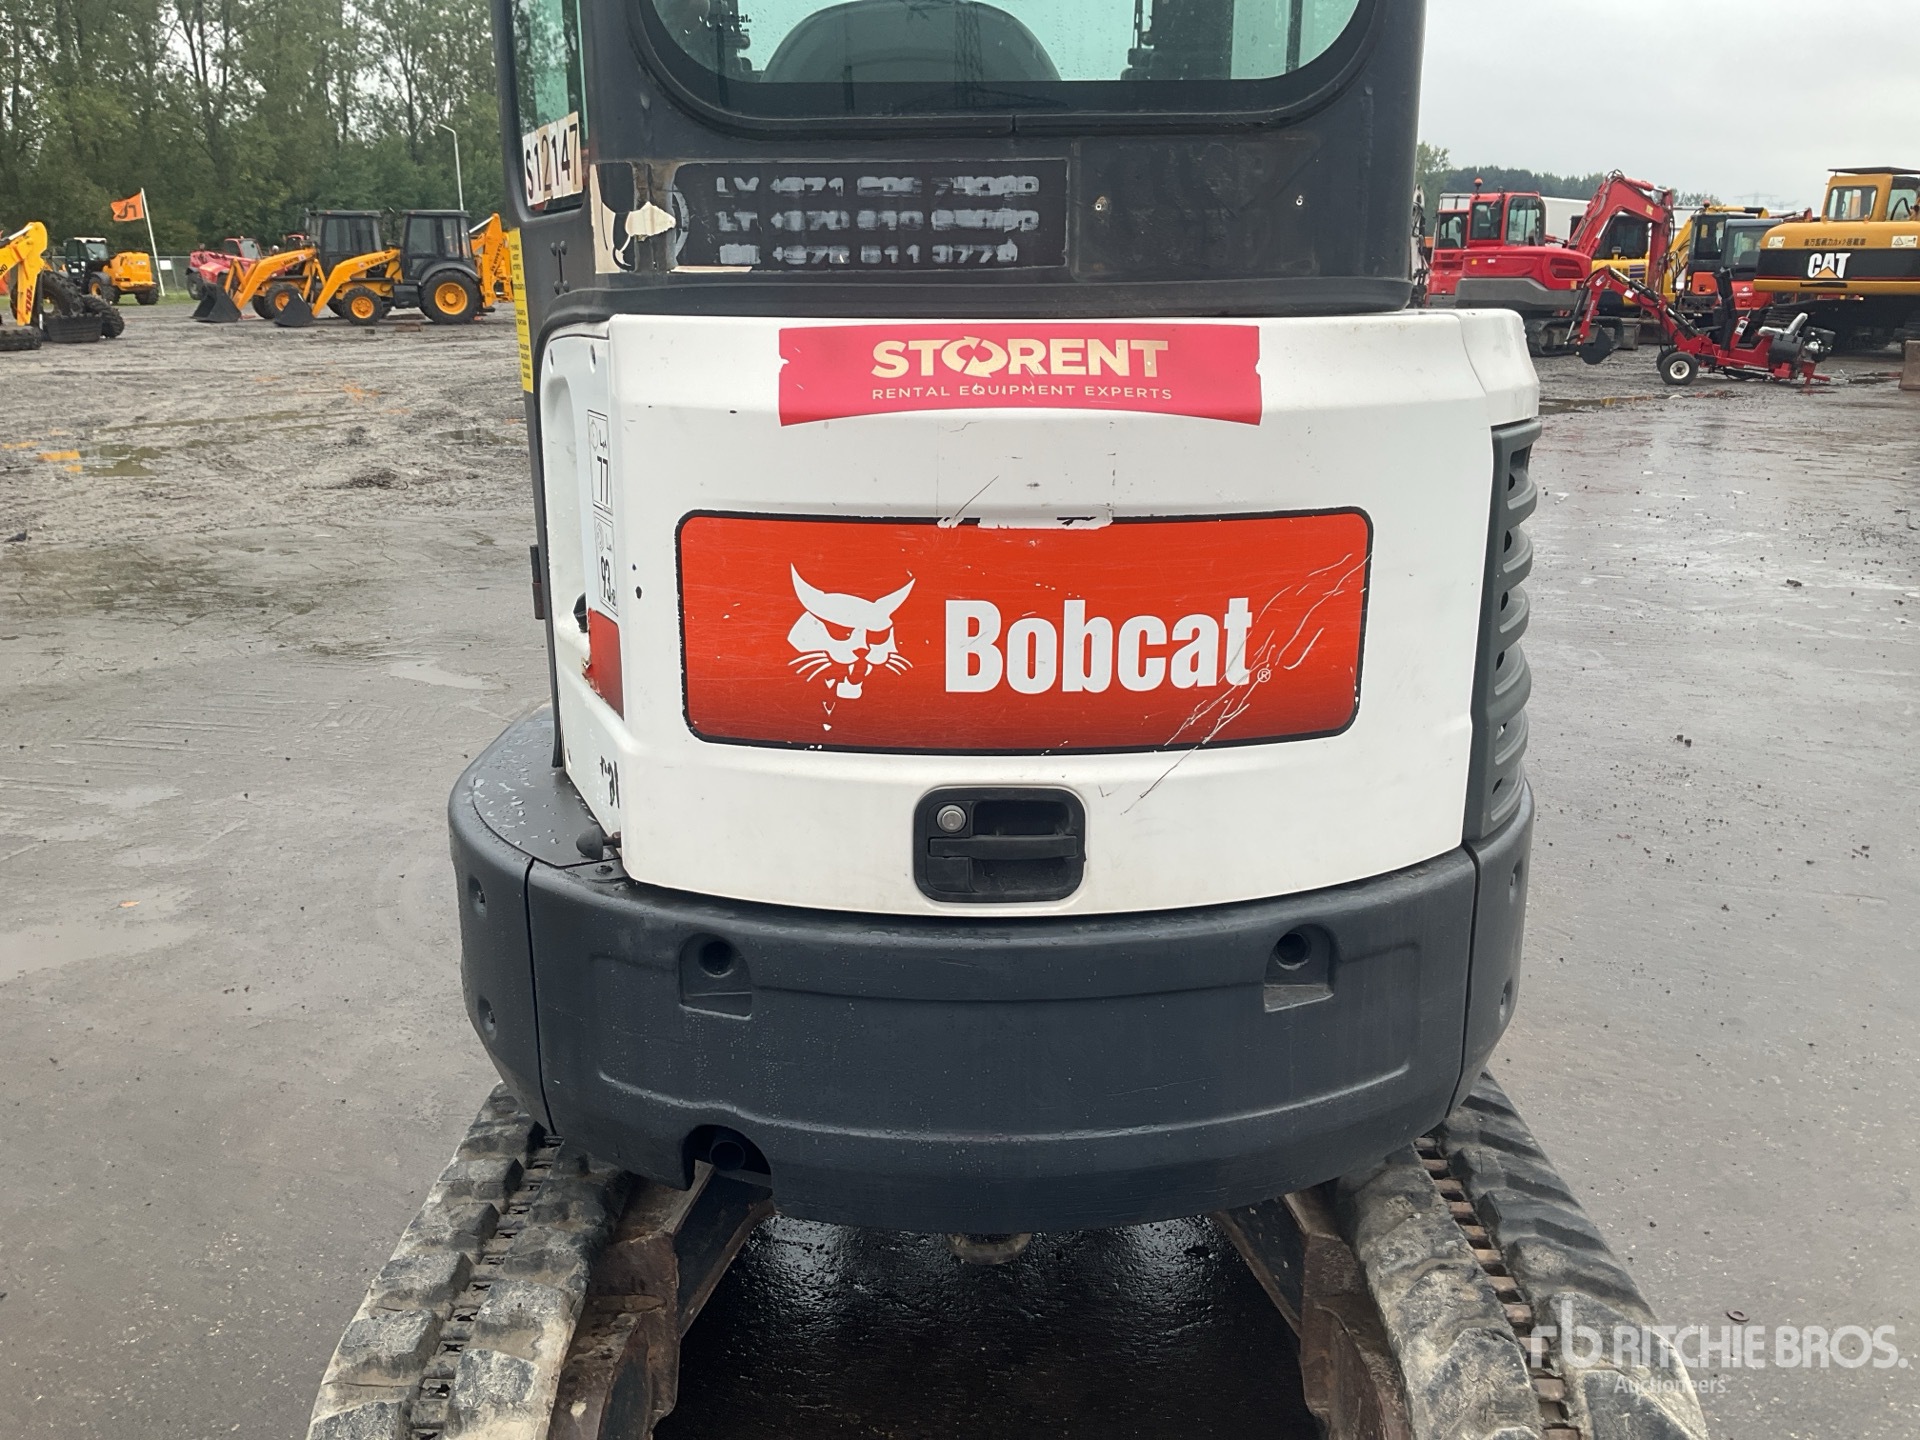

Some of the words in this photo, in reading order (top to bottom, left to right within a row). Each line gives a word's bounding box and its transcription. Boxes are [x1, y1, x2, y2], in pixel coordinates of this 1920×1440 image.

[525, 122, 578, 200] S12147
[1807, 252, 1851, 278] CAT
[871, 335, 1168, 378] STORENT
[872, 386, 950, 400] RENTAL
[959, 384, 1076, 397] EQUIPMENT
[1085, 386, 1172, 400] EXPERTS
[597, 455, 609, 505] 77
[945, 597, 1252, 693] Bobcat
